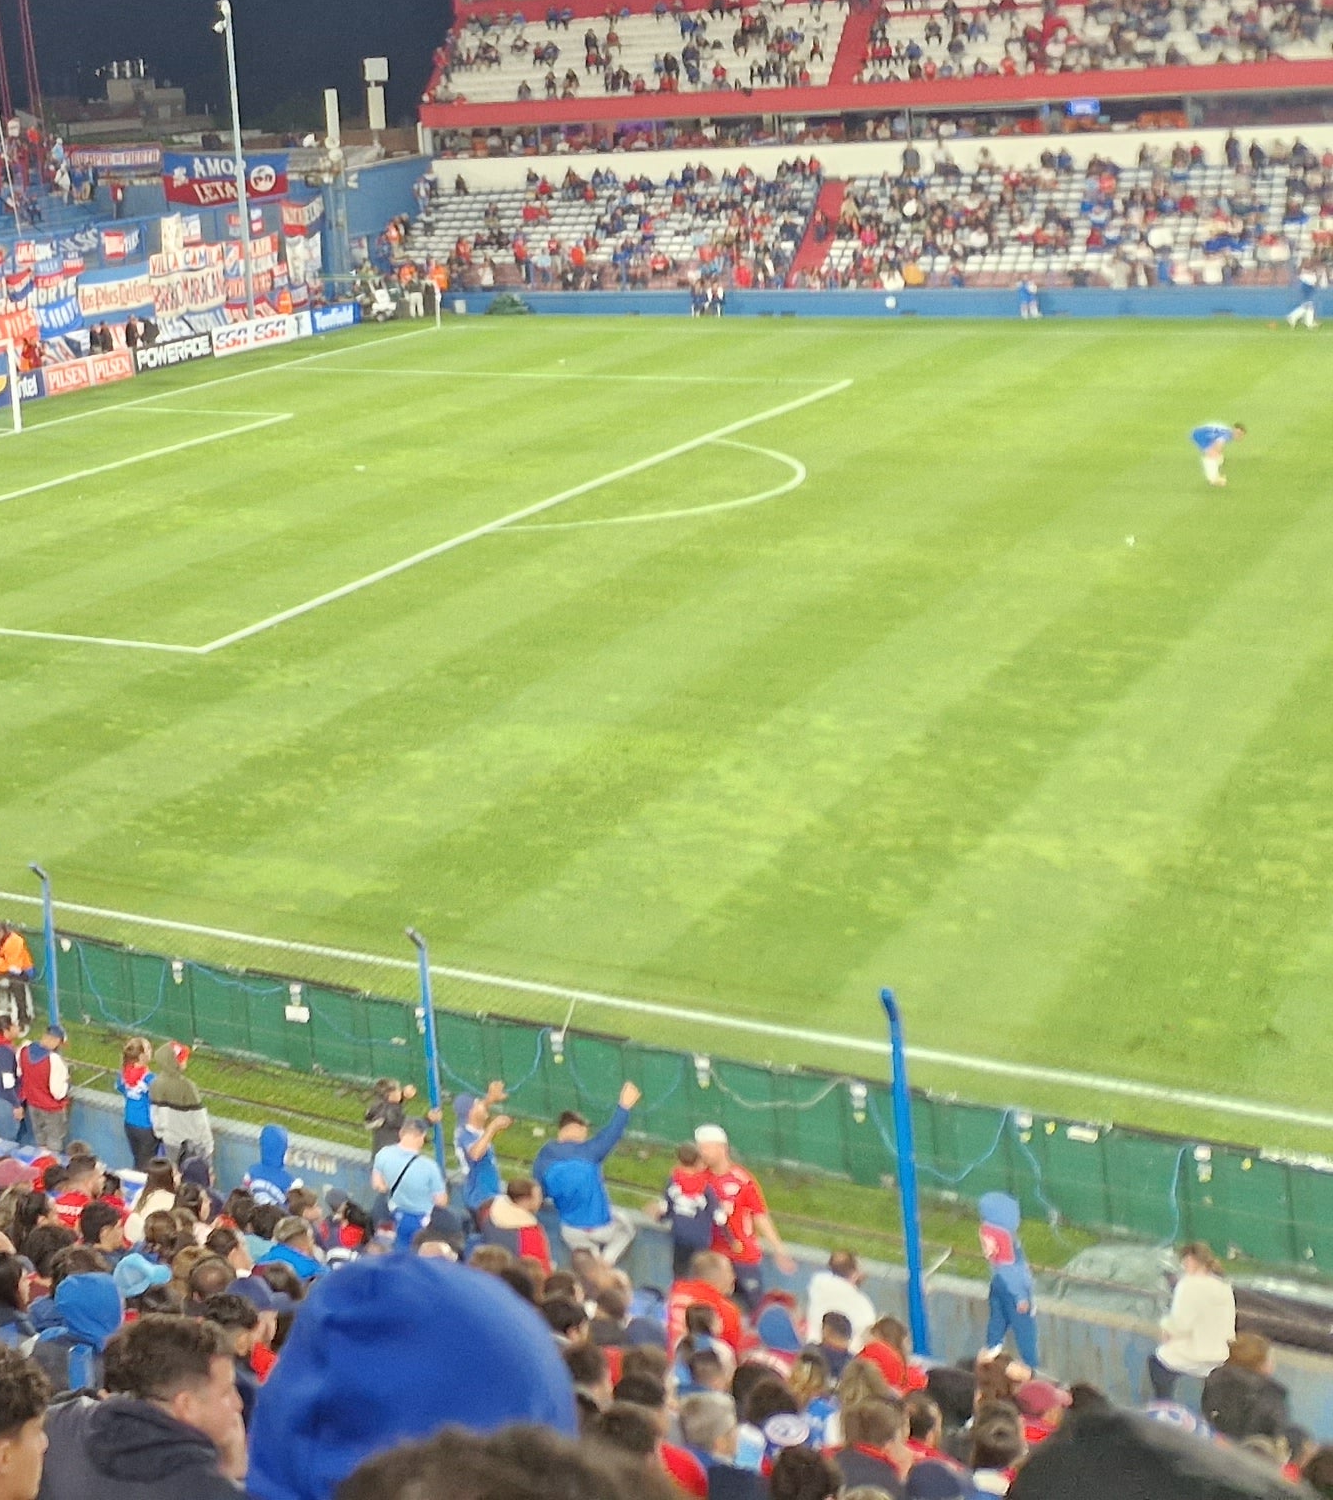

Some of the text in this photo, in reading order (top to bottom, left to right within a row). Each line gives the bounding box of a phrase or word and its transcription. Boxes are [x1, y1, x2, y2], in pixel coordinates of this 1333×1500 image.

[152, 248, 224, 276] VILLA CAMILA
[137, 335, 211, 371] POWERADE
[16, 370, 38, 400] ntel
[47, 356, 132, 391] PILSEN PILSEN
